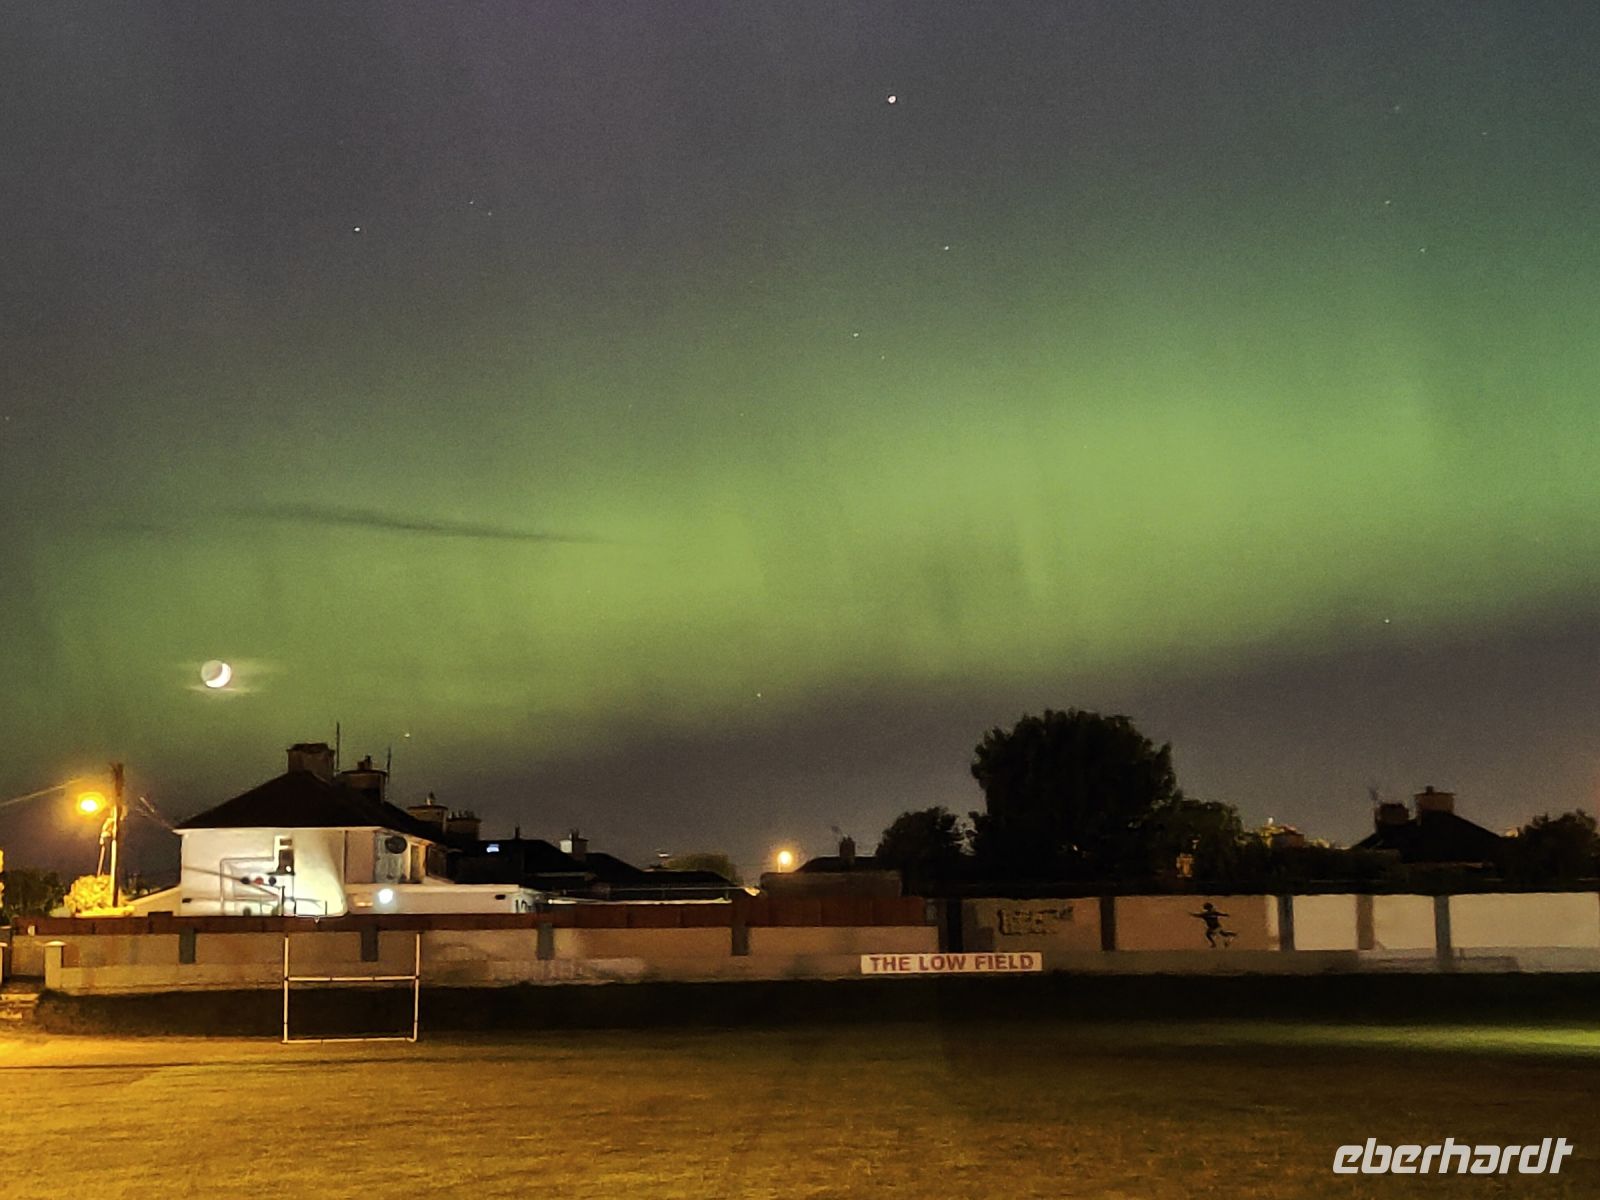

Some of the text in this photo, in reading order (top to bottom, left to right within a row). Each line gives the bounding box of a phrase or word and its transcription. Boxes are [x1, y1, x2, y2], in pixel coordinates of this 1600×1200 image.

[869, 955, 1034, 972] THE LOW FIELD
